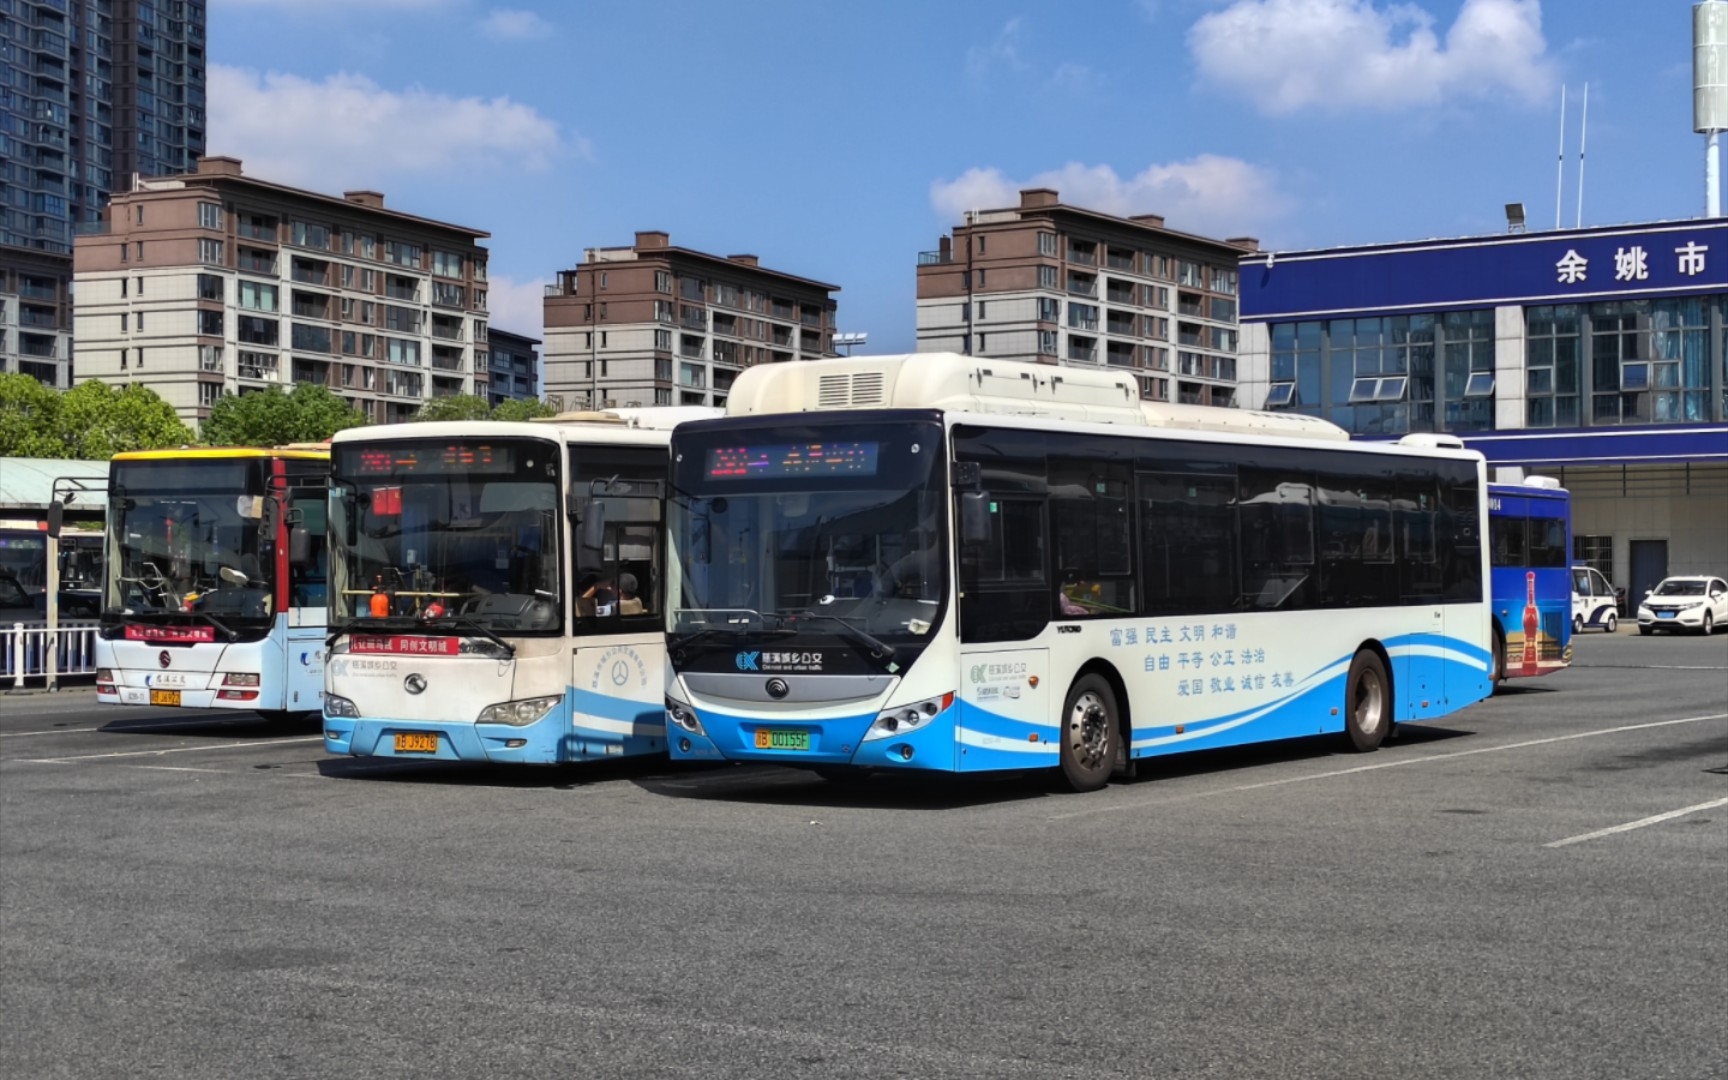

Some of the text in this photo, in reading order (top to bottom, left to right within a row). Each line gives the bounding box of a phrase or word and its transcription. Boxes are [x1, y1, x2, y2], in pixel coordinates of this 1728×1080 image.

[1555, 241, 1708, 284] 余姚市
[1110, 623, 1237, 647] 富强 民主 文明 和谐
[1144, 648, 1265, 672] 自由 平等 公正 法治
[1177, 672, 1295, 696] 爱国 敬业 诚信 友善
